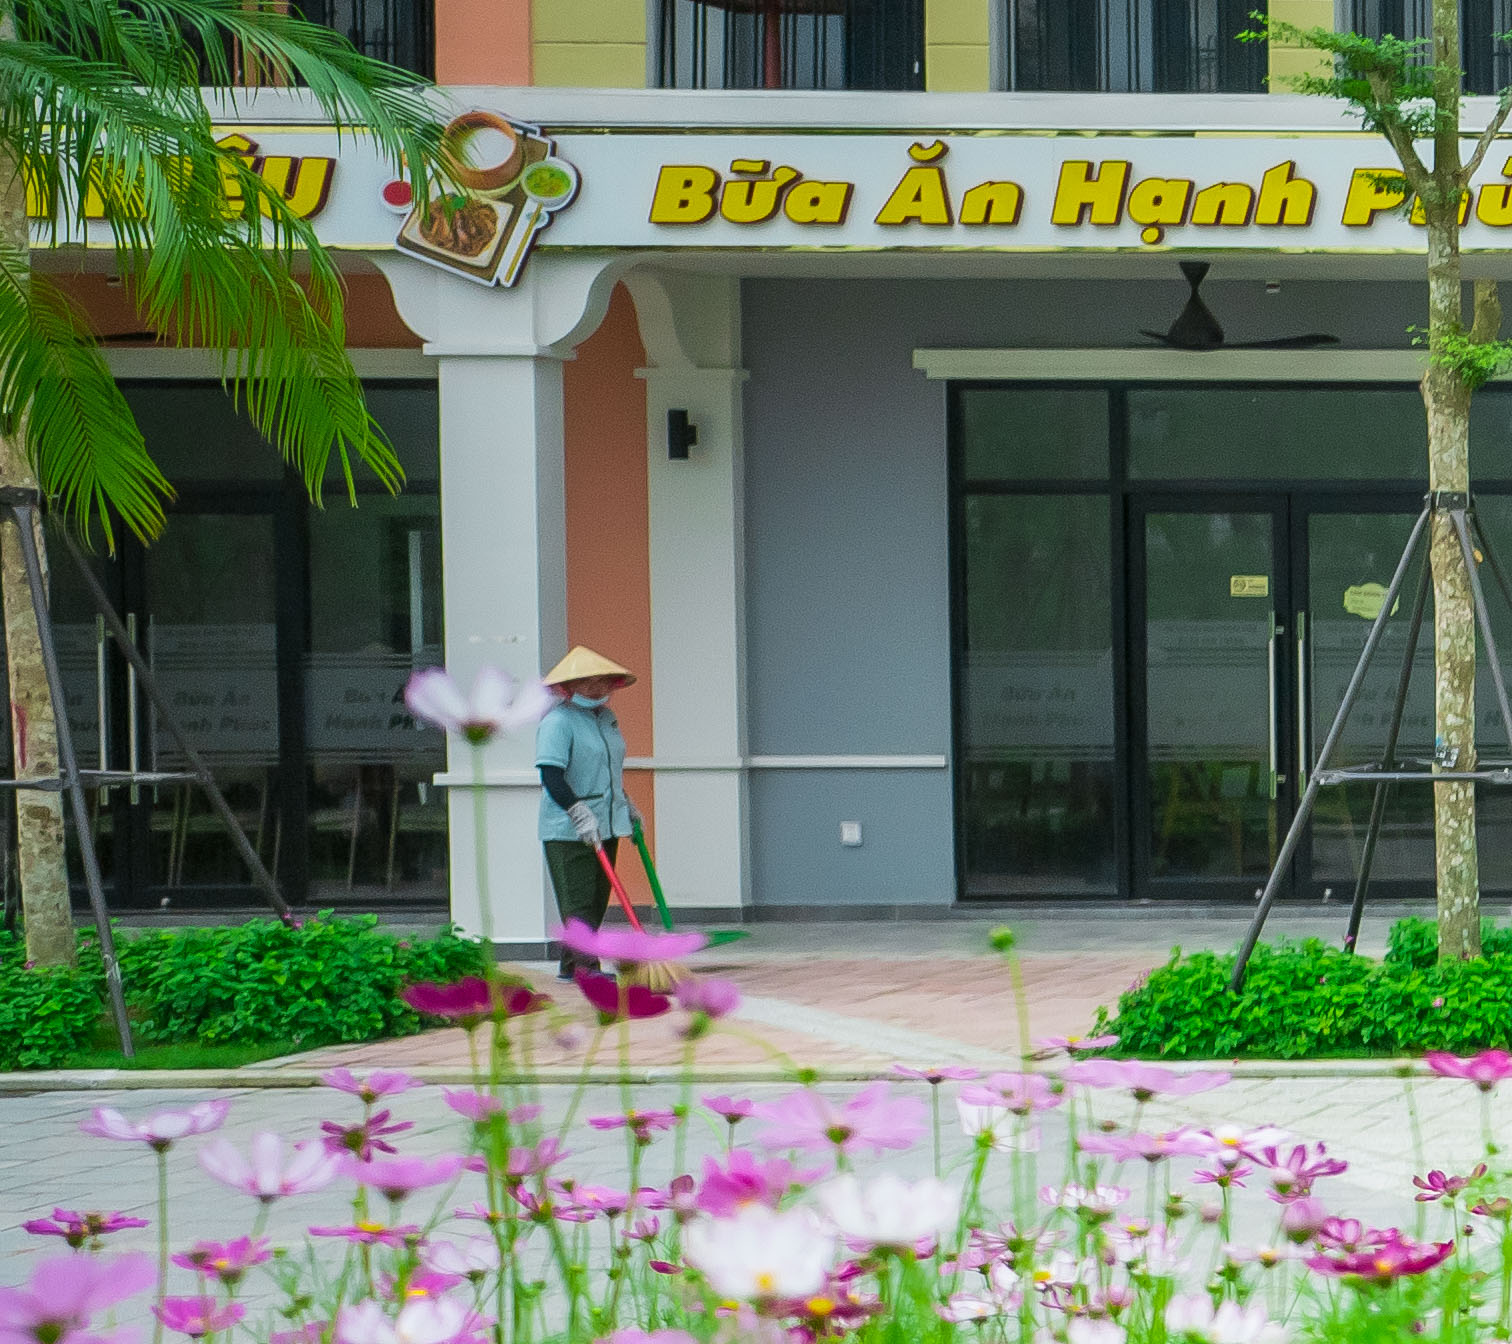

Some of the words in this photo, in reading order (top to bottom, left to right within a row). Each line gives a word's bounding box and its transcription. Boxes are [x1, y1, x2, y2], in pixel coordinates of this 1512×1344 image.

[649, 159, 854, 226] Bữa
[874, 140, 1025, 227] Ăn
[1051, 160, 1317, 245] Hạnh
